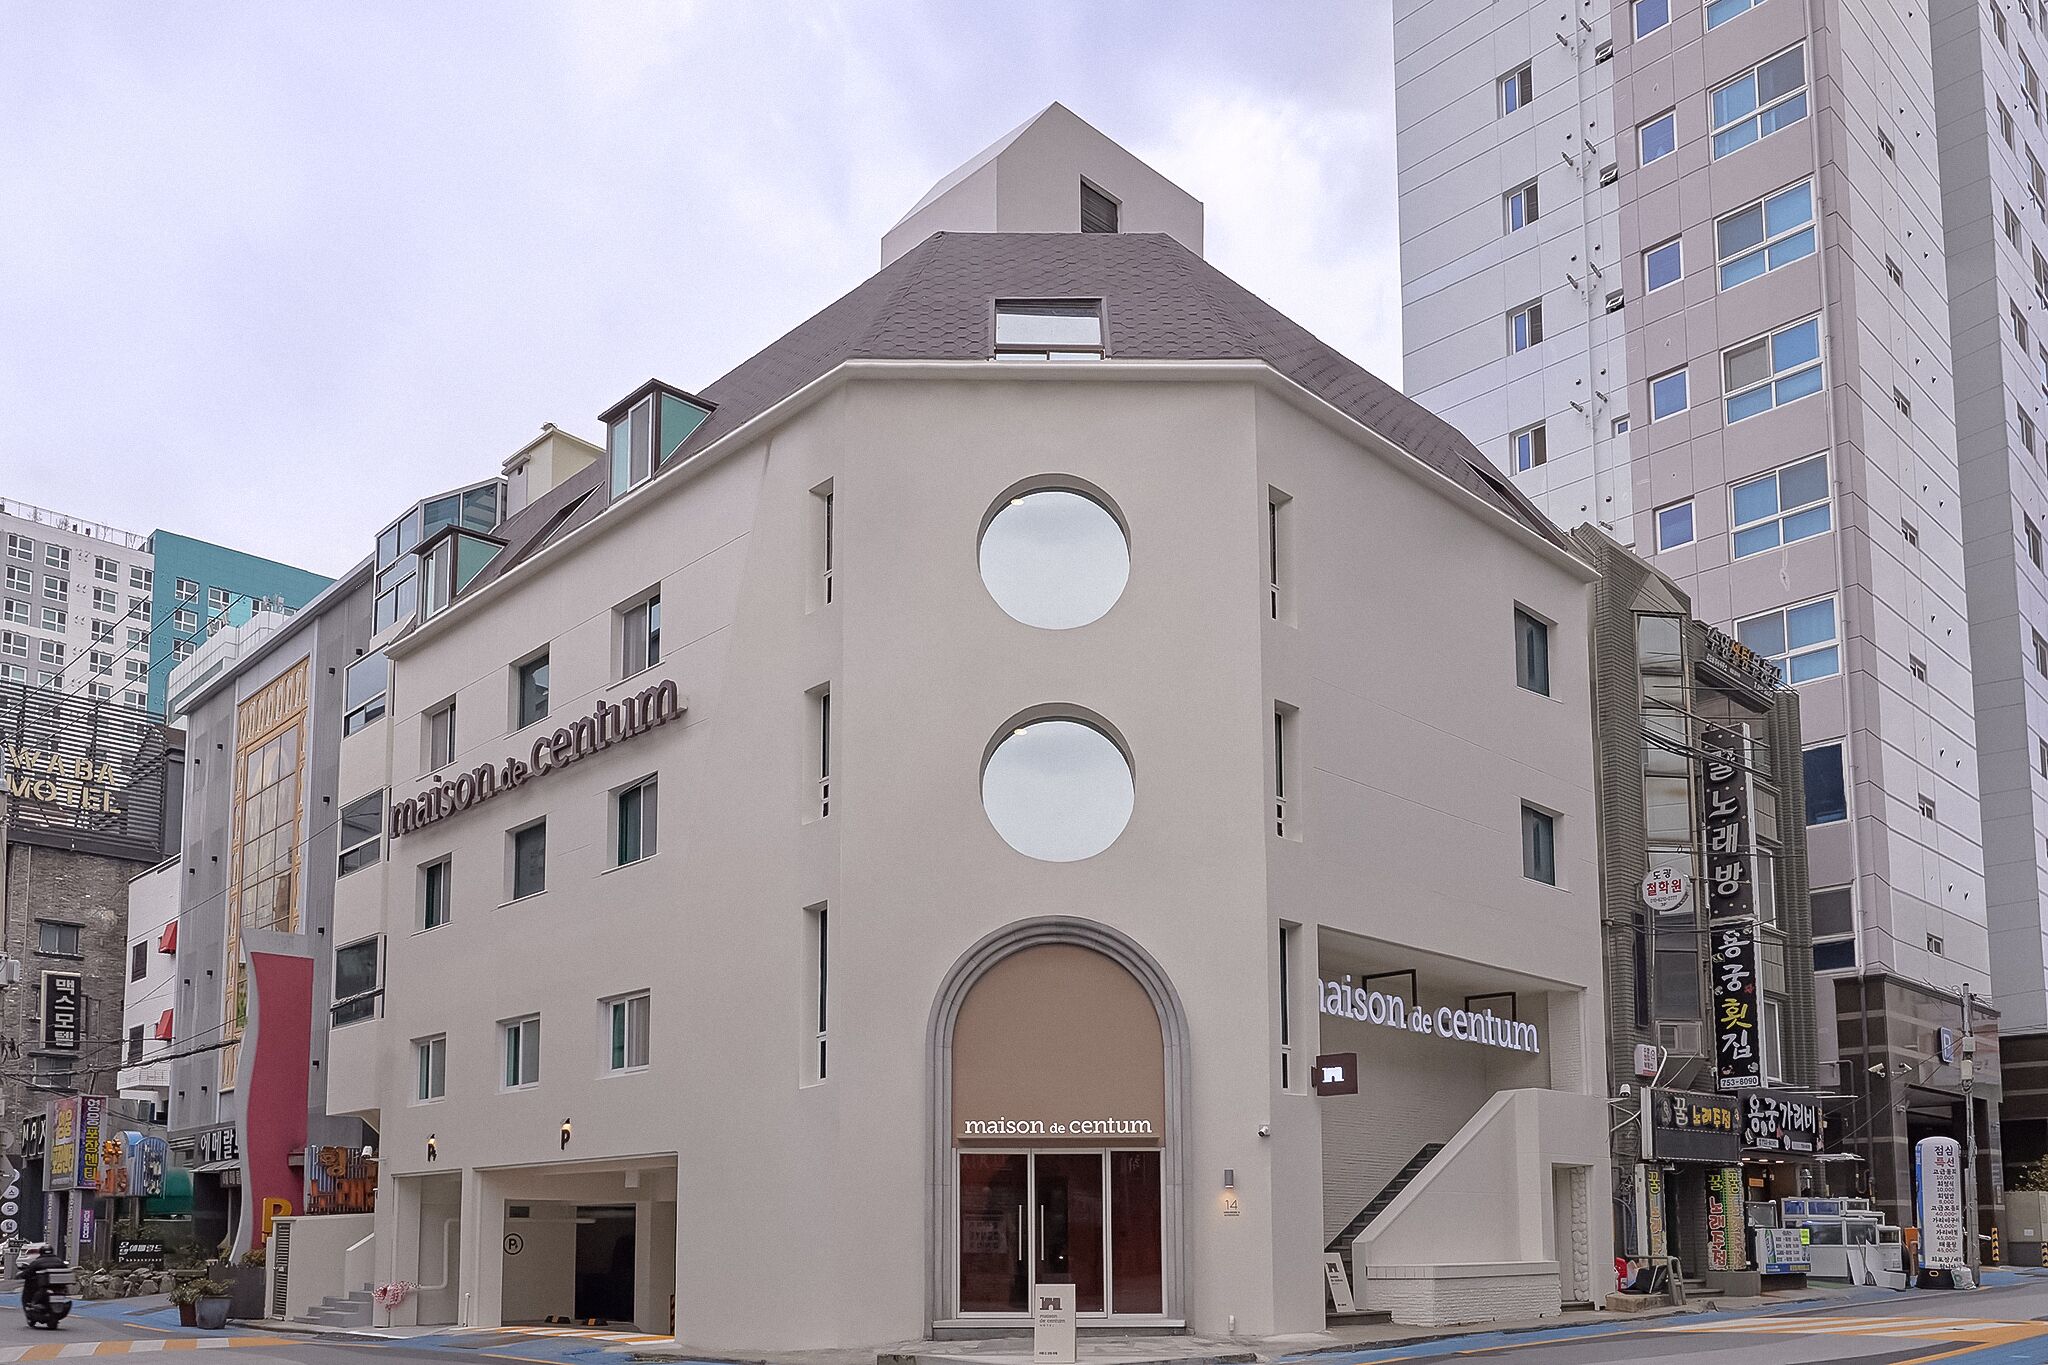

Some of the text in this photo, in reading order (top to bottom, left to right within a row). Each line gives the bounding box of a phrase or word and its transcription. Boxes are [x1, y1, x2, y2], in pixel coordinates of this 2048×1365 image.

[7, 745, 116, 785] WABA
[390, 678, 682, 839] maison de centum
[6, 773, 121, 814] MOTEL
[55, 979, 75, 1047] 맥스모텔
[1409, 1006, 1433, 1034] de
[1434, 1006, 1540, 1054] centum
[1722, 1076, 1758, 1087] 753-8090
[964, 1117, 1152, 1134] maison de centum
[1748, 1094, 1816, 1133] 용궁가리비
[200, 1129, 240, 1161] 에메랄
[1935, 1145, 1954, 1156] 점심
[1935, 1157, 1955, 1167] 특선
[262, 1197, 292, 1234] P
[1225, 1199, 1237, 1210] 14
